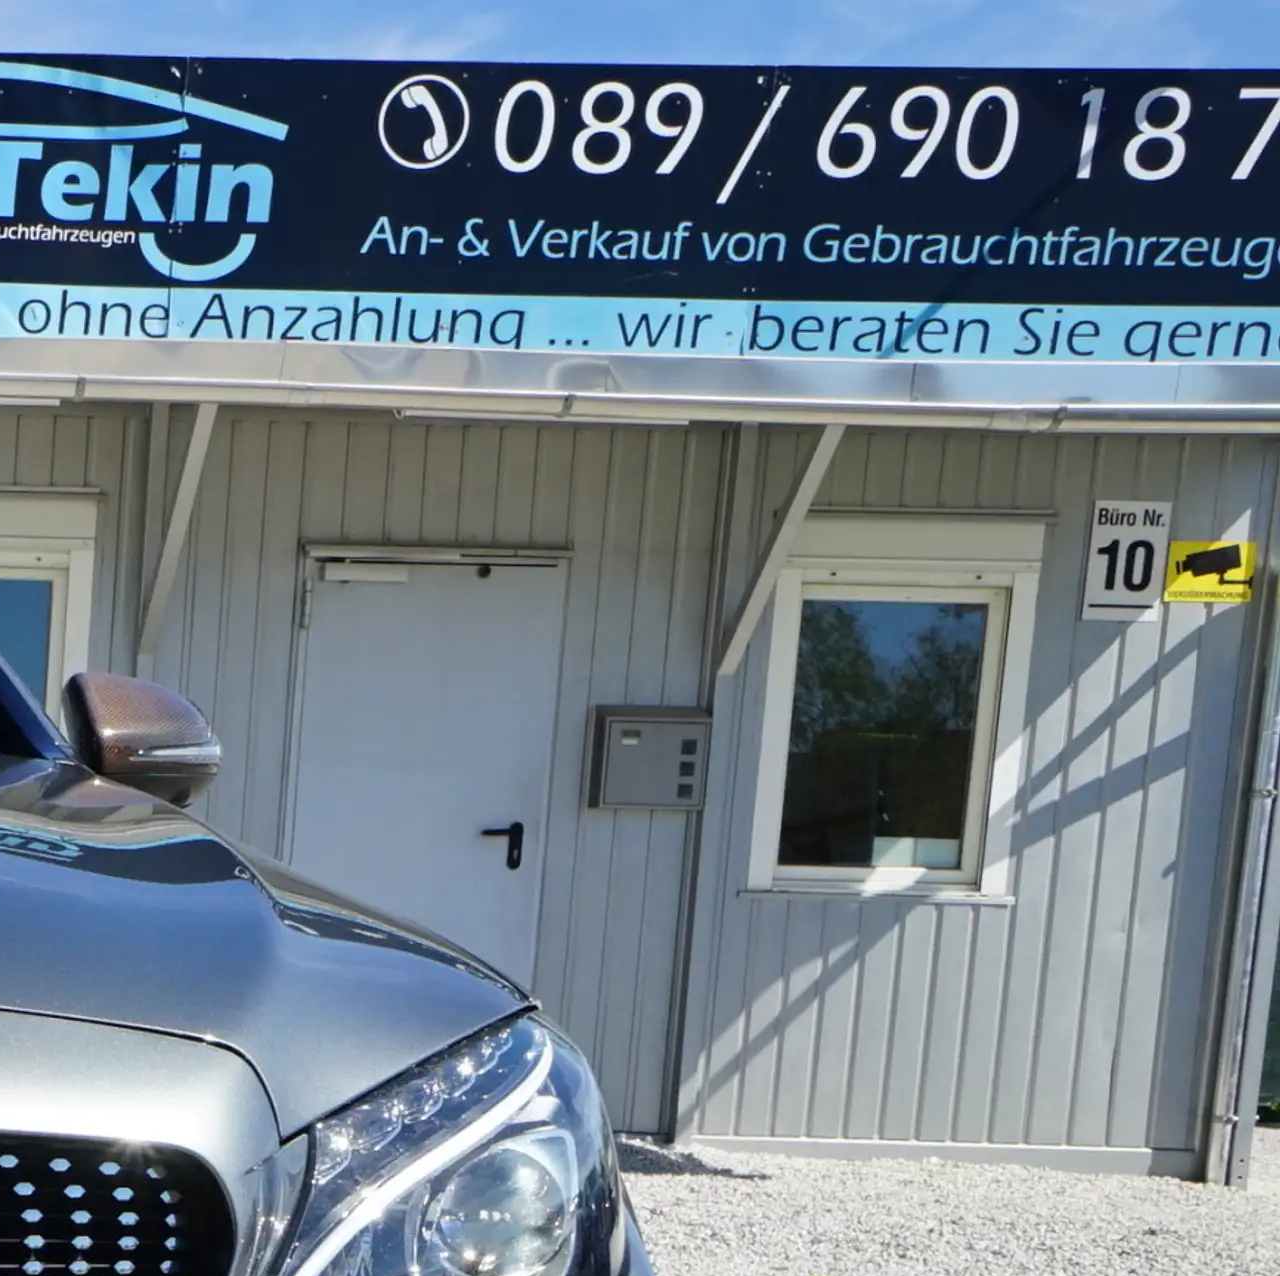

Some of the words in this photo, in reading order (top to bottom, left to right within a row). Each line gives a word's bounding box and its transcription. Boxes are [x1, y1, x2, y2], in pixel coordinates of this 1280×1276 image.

[494, 80, 705, 175] 089
[816, 85, 1020, 180] 690
[360, 215, 444, 256] An-
[457, 217, 491, 257] &
[508, 218, 694, 262] Verkauf
[700, 231, 788, 263] von
[803, 223, 1280, 281] Gebrauchtfahrzeug
[17, 289, 171, 339] ohne
[189, 293, 527, 351] Anzahlung
[617, 301, 714, 350] wir
[748, 303, 991, 355] beraten
[1012, 306, 1102, 358] Sie
[1123, 320, 1280, 364] gern
[1097, 507, 1137, 528] Büro
[1142, 509, 1166, 528] Nr.
[1096, 538, 1156, 593] 10
